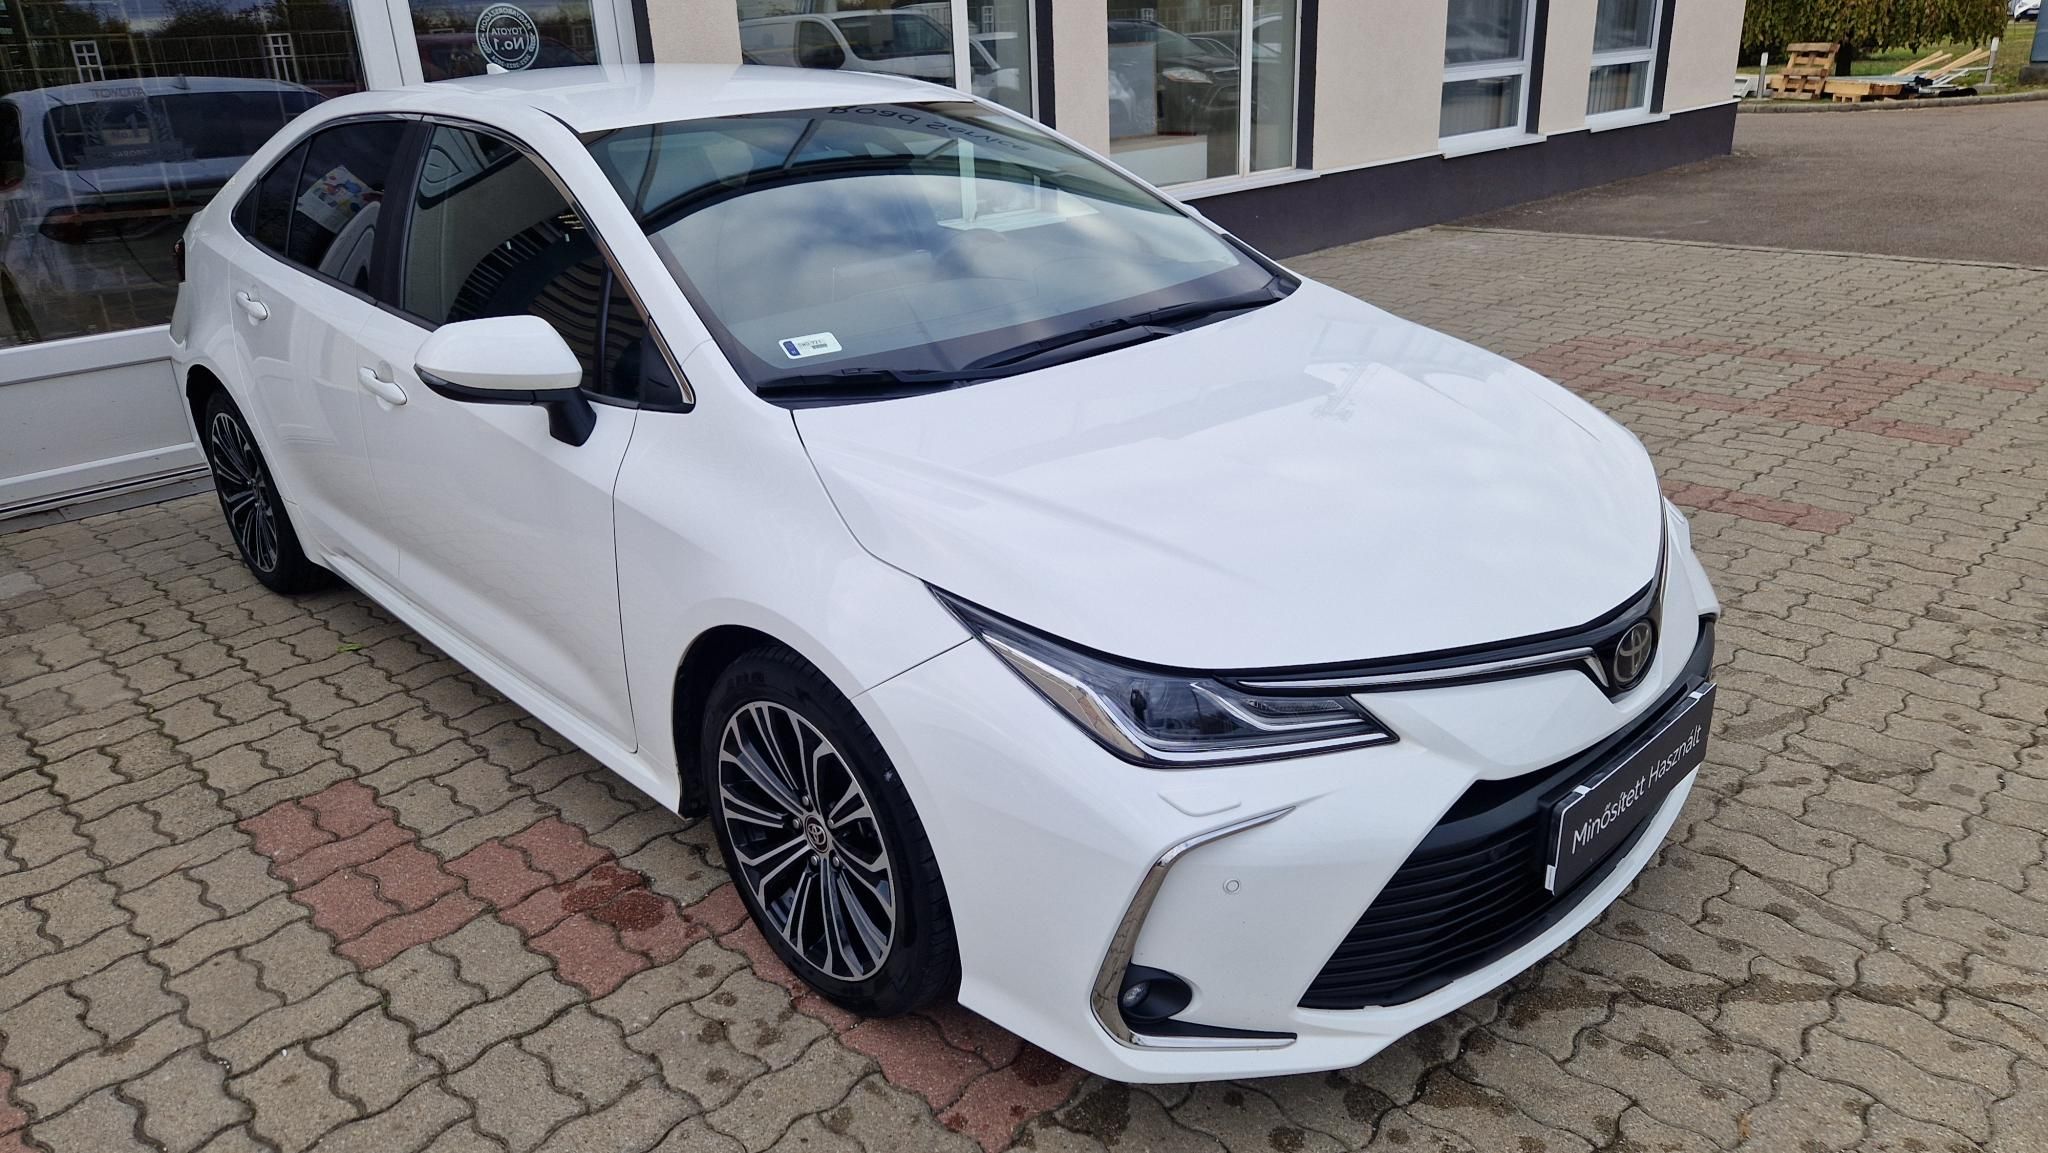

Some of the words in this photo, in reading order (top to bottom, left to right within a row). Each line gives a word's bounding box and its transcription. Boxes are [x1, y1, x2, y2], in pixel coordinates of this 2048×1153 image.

[88, 86, 146, 98] TOYOTA
[1571, 776, 1645, 855] Minősített
[1648, 725, 1702, 788] Használt
